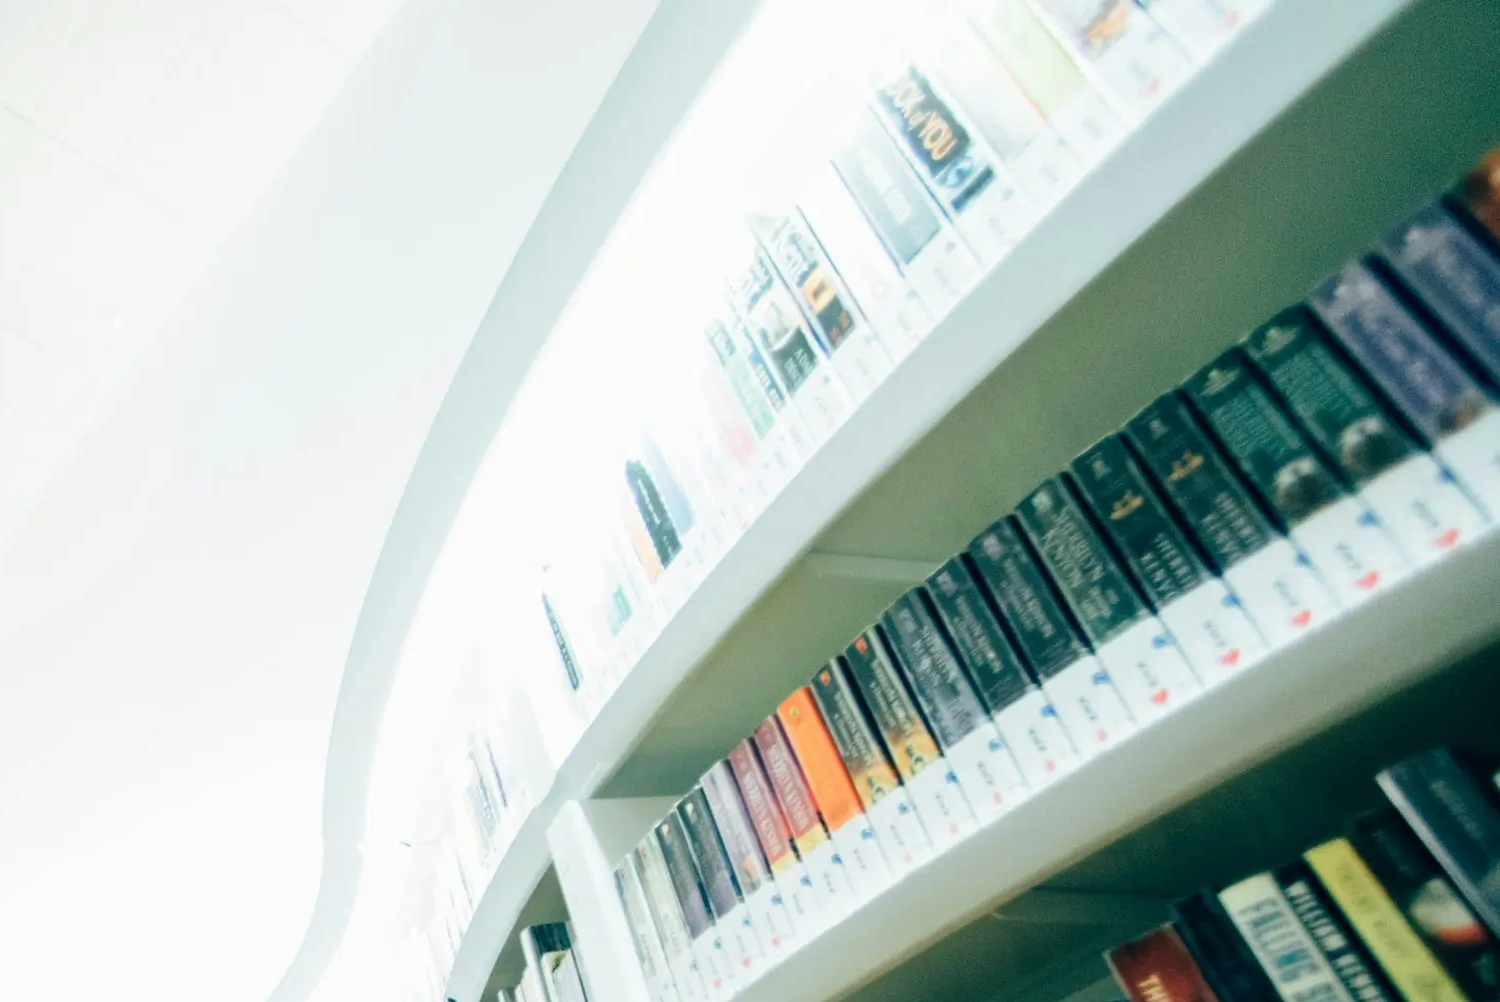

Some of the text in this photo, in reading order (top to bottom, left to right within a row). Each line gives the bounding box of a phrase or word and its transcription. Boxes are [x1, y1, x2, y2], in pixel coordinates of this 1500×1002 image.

[909, 110, 962, 163] YOU
[1233, 898, 1322, 984] FALLING
[1281, 881, 1349, 954] WILLIAM
